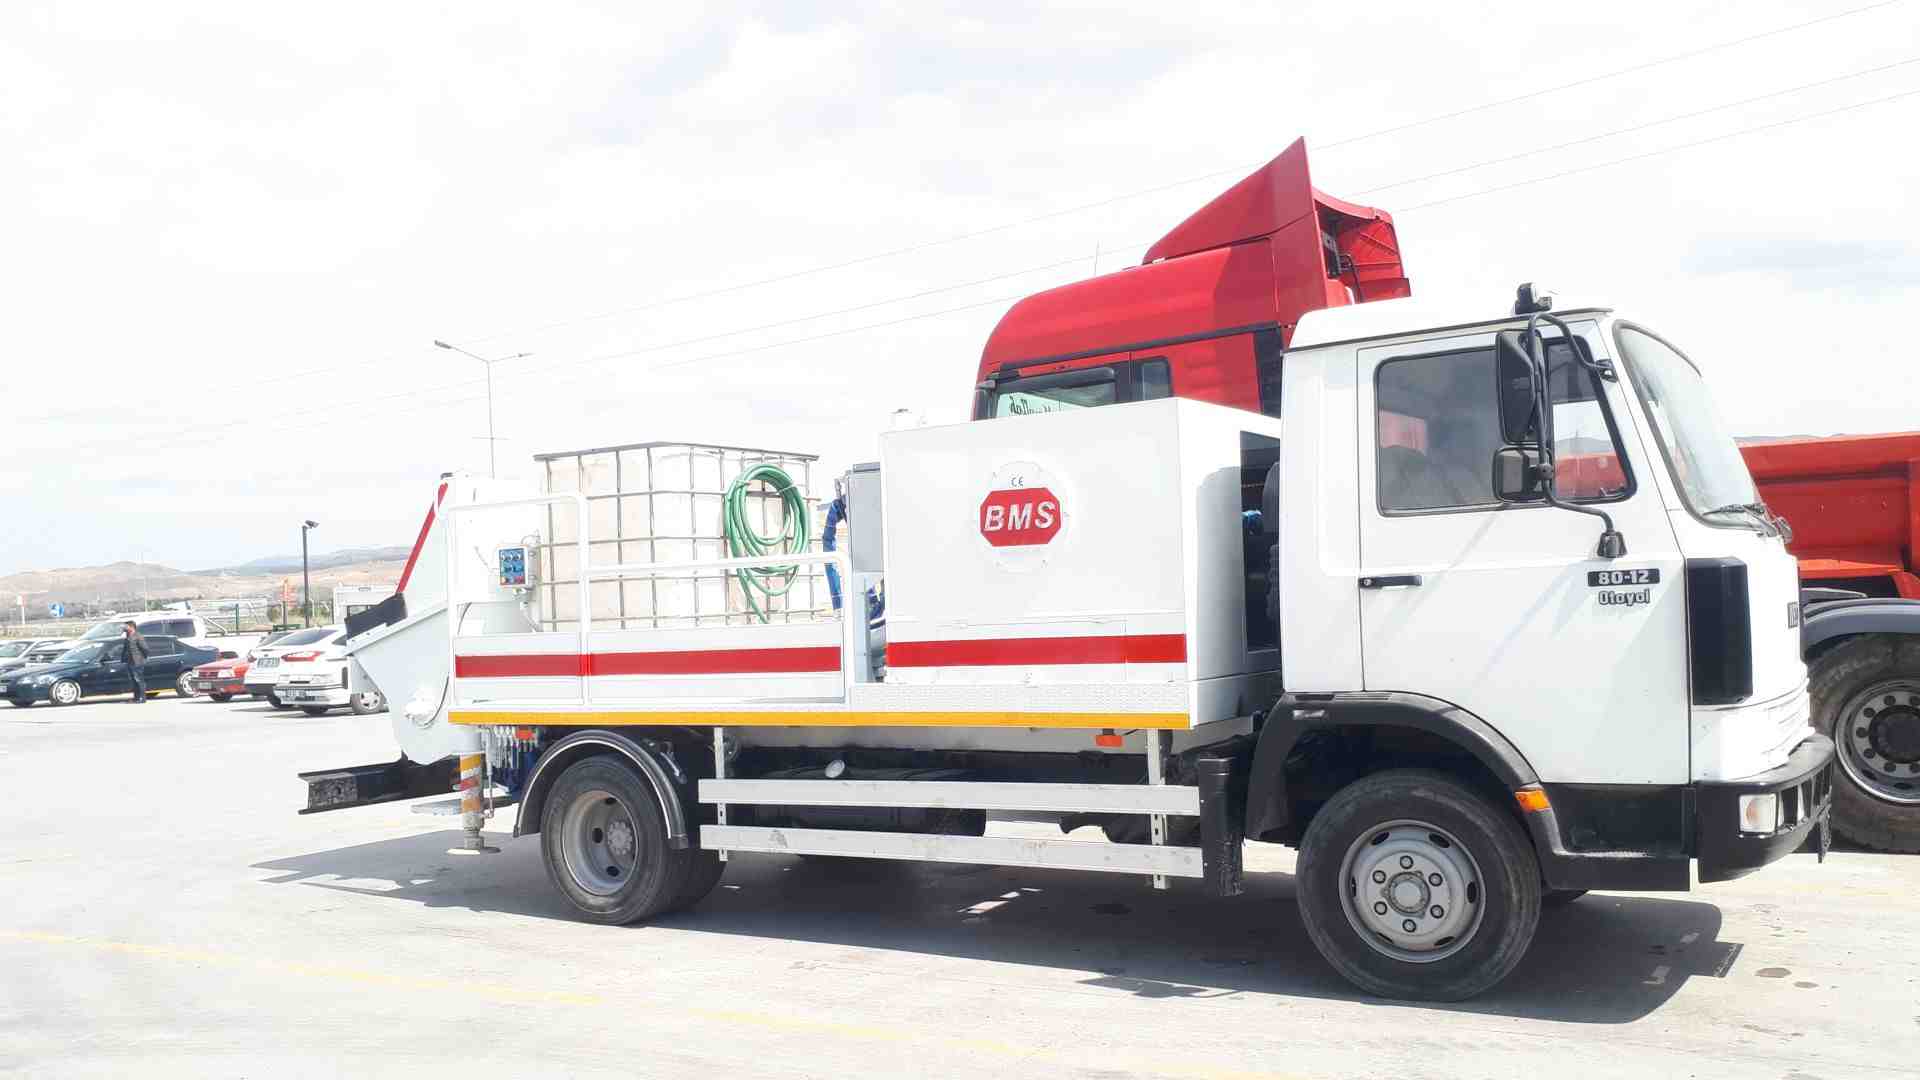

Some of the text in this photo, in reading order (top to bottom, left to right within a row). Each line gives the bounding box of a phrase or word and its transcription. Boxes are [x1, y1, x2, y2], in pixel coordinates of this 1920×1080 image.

[1011, 477, 1024, 488] CE
[984, 501, 1056, 532] BMS
[1598, 569, 1649, 585] 80-12
[1598, 589, 1651, 606] Otoyol
